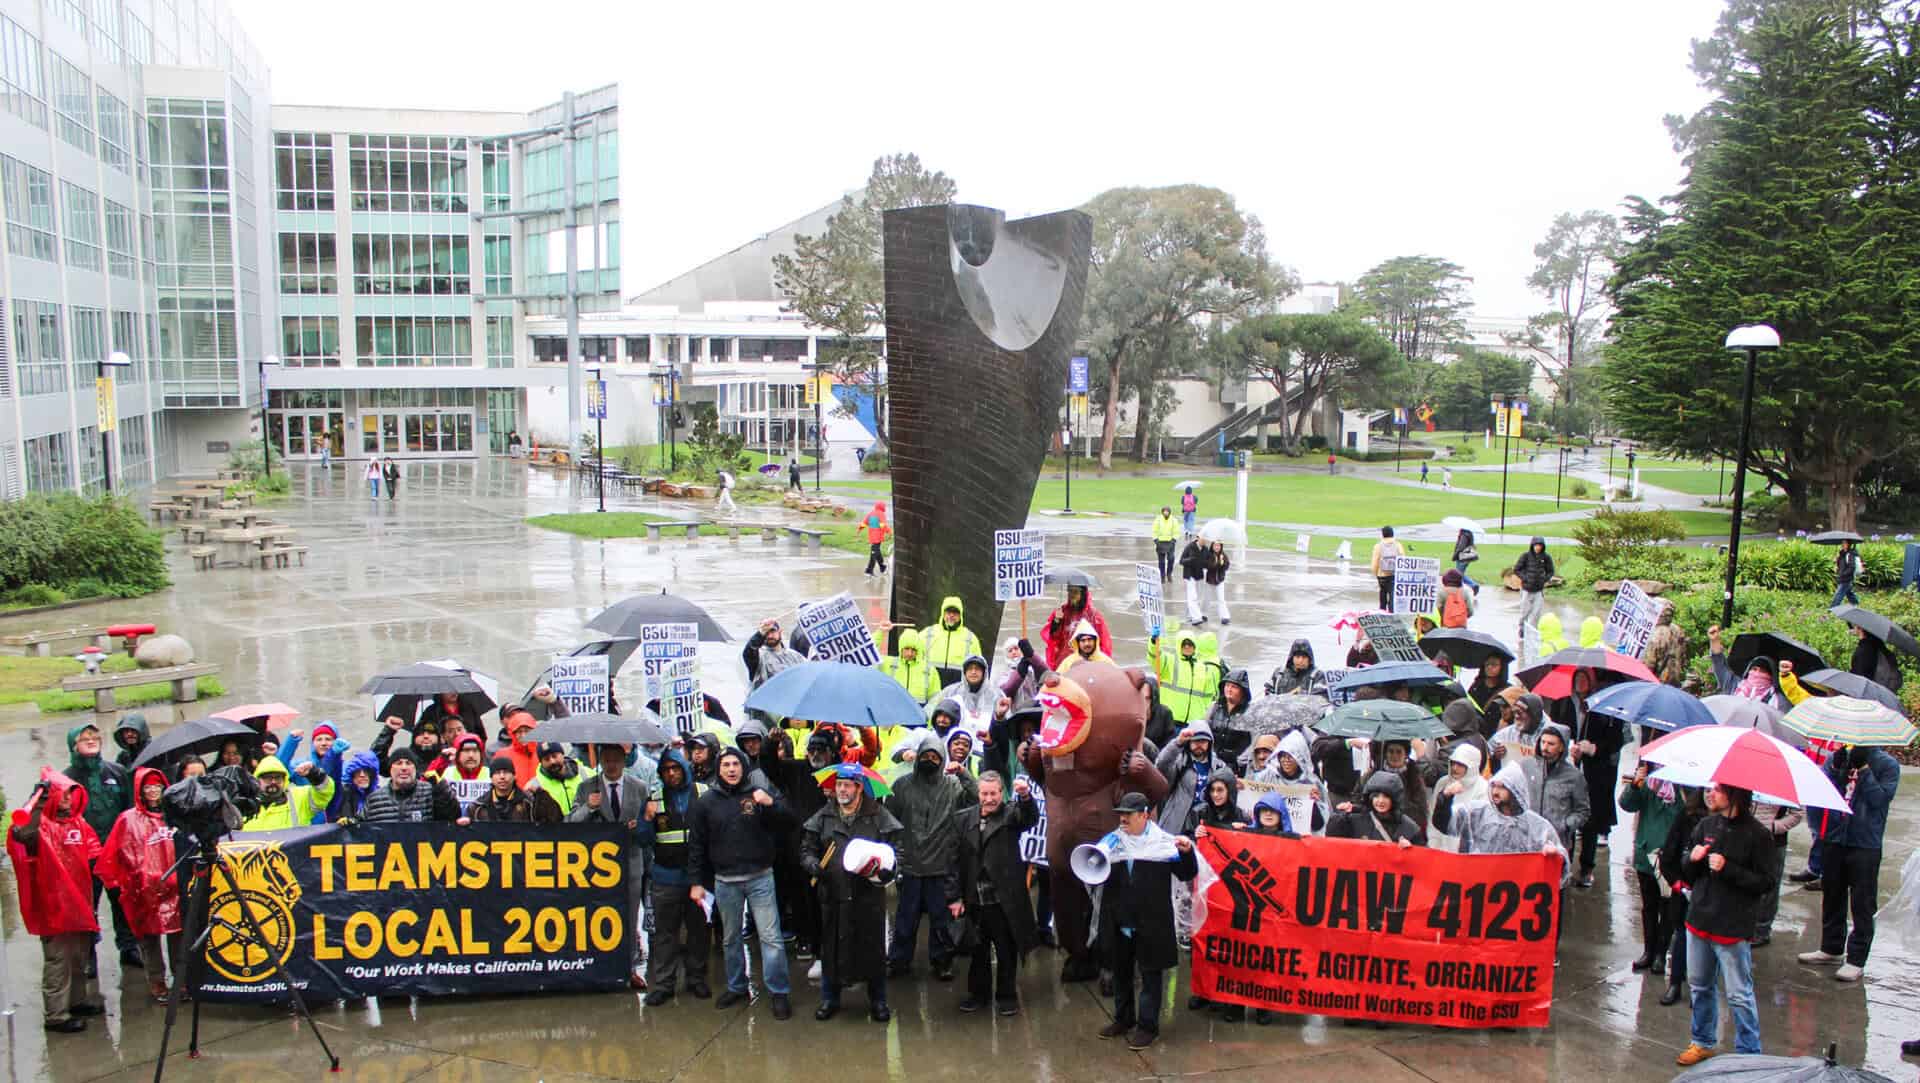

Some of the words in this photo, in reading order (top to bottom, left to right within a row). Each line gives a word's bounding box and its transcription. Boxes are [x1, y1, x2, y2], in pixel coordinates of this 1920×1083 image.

[997, 532, 1020, 545] CSU
[1000, 549, 1016, 560] PAY
[1019, 548, 1031, 559] UP
[1033, 550, 1042, 560] OR
[998, 561, 1043, 578] STRIKE
[1397, 558, 1417, 569] CSU
[1016, 577, 1043, 597] OUT
[1396, 584, 1436, 598] STRIKE
[1621, 582, 1641, 602] CSU
[1410, 598, 1435, 613] OUT
[801, 605, 827, 628] CSU
[643, 625, 668, 640] CSU
[810, 626, 831, 643] PAY
[831, 618, 846, 633] UP
[846, 614, 862, 628] OR
[1610, 609, 1649, 645] STRIKE
[646, 644, 666, 657] PAY
[669, 644, 681, 657] UP
[683, 647, 697, 657] OR
[816, 625, 871, 660] STRIKE
[1372, 636, 1416, 649] STRIKE
[553, 663, 577, 678] CSU
[576, 680, 591, 694] UP
[592, 683, 605, 694] OR
[676, 680, 690, 694] UP
[563, 695, 605, 713] TRIKE
[676, 709, 703, 733] OUT
[310, 841, 622, 892] TEAMSTERS
[1296, 866, 1414, 935] UAW
[1427, 880, 1553, 942] 4123
[313, 908, 490, 960] LOCAL
[503, 906, 623, 954] 2010
[384, 963, 424, 977] Work
[426, 961, 471, 975] Makes
[474, 960, 544, 975] California
[1205, 935, 1309, 980] EDUCATE,
[1317, 950, 1416, 991] AGITATE,
[1425, 960, 1538, 993] ORGANIZE
[1216, 975, 1293, 1005] Academic
[1298, 990, 1361, 1011] Student
[1365, 995, 1433, 1017] Workers
[1438, 1000, 1456, 1018] at
[1460, 1001, 1487, 1020] the
